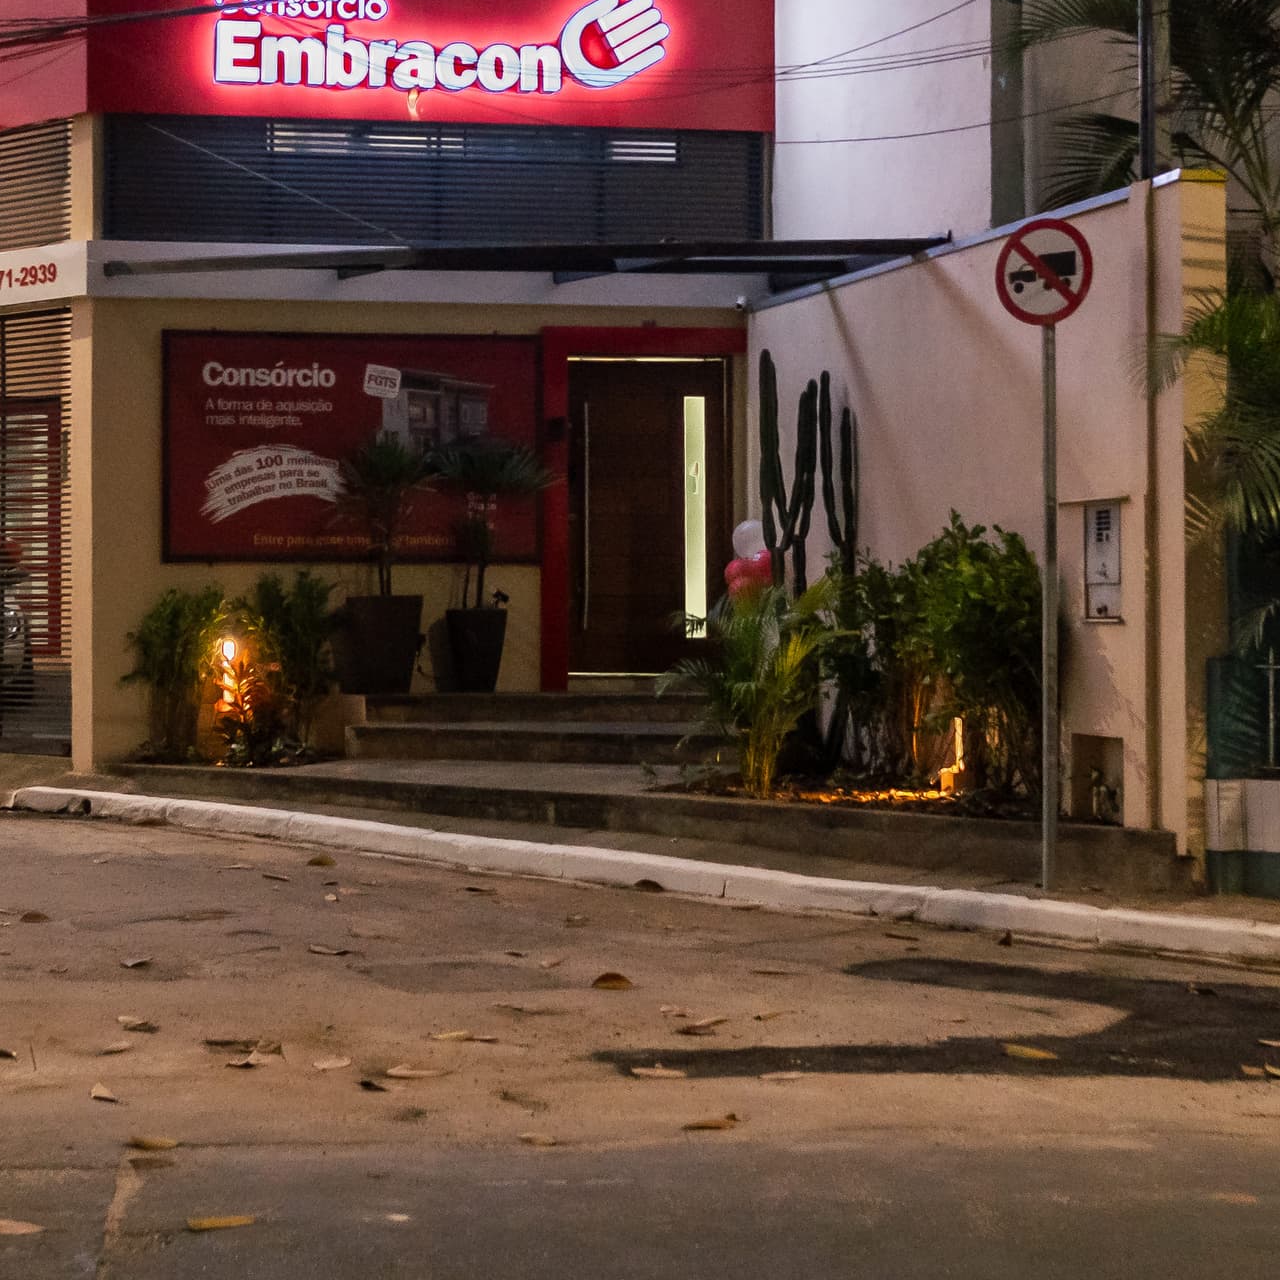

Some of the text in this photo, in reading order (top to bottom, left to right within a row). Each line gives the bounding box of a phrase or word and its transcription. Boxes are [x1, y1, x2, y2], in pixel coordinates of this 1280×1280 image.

[214, 19, 563, 93] Embracon
[202, 360, 336, 388] Consórcio
[367, 373, 398, 389] FGTS
[205, 397, 333, 414] A forma de aquisição
[205, 413, 304, 428] mais inteligente.
[207, 473, 233, 490] Uma
[233, 465, 254, 478] das
[255, 454, 284, 470] 100
[223, 468, 320, 495] empresas para se
[227, 483, 276, 506] trabalhar
[278, 480, 294, 491] no
